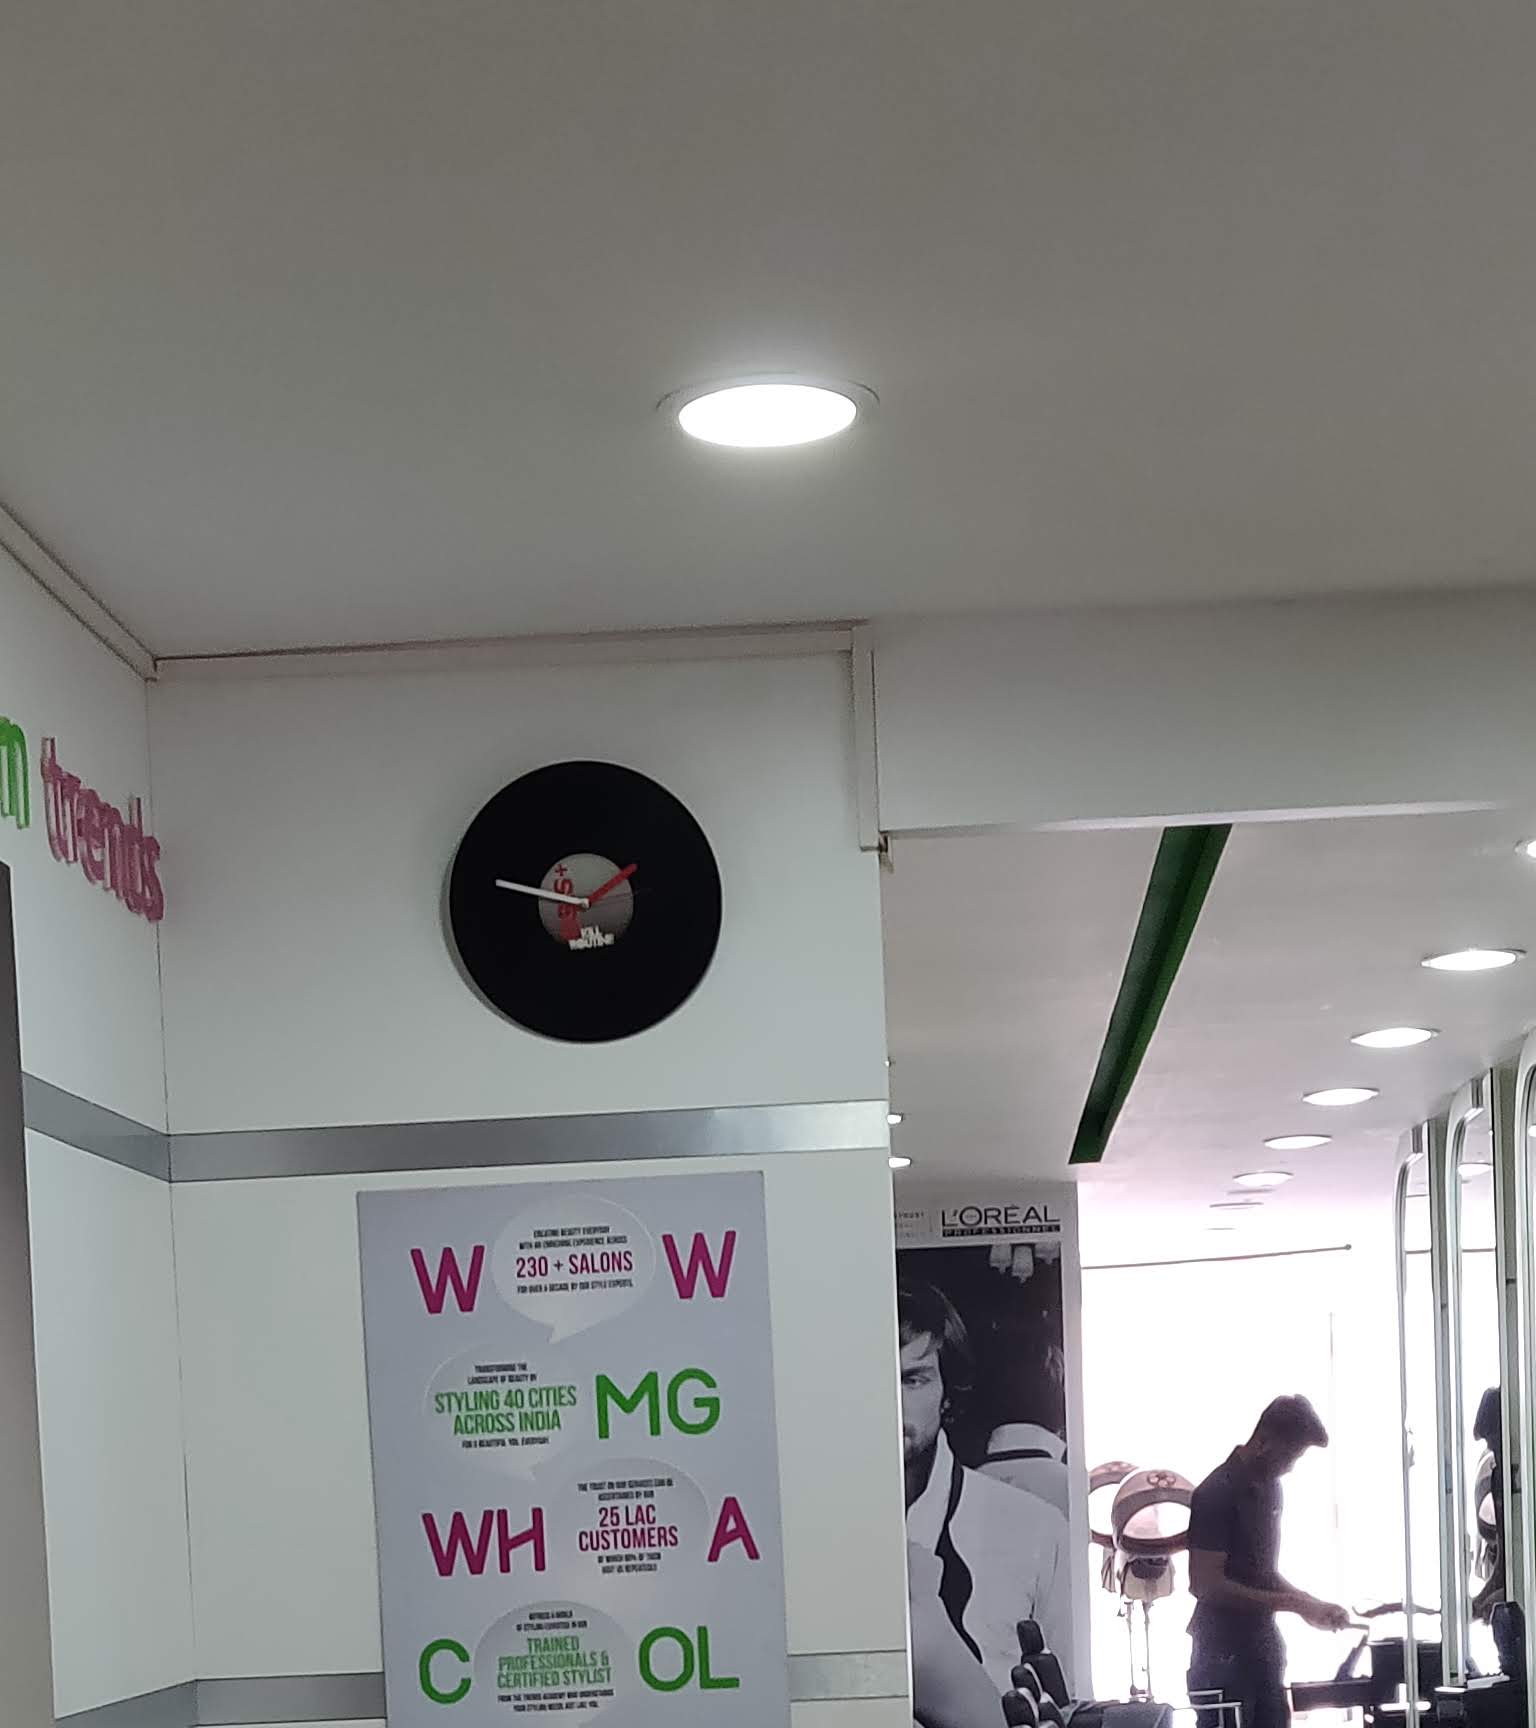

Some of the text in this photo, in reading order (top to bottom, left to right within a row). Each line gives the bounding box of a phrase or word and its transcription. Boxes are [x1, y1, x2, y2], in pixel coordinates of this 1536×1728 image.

[40, 737, 163, 923] trends
[410, 1245, 485, 1314] W
[516, 1250, 633, 1278] 230 + SALONS
[662, 1230, 736, 1299] W
[435, 1385, 577, 1414] STYLING 40 CITIES
[454, 1409, 561, 1436] ACROSS INDIA
[595, 1367, 720, 1439] MG
[579, 1525, 678, 1552] CUSTOMERS
[598, 1504, 656, 1527] 25 LAC
[707, 1496, 760, 1562] A
[422, 1507, 546, 1577] WH
[498, 1651, 597, 1671] PROFESSIONALS
[527, 1635, 579, 1653] TRAINED
[638, 1625, 740, 1692] OL
[419, 1638, 471, 1704] C
[497, 1667, 611, 1688] CERTIFIED STYLIST
